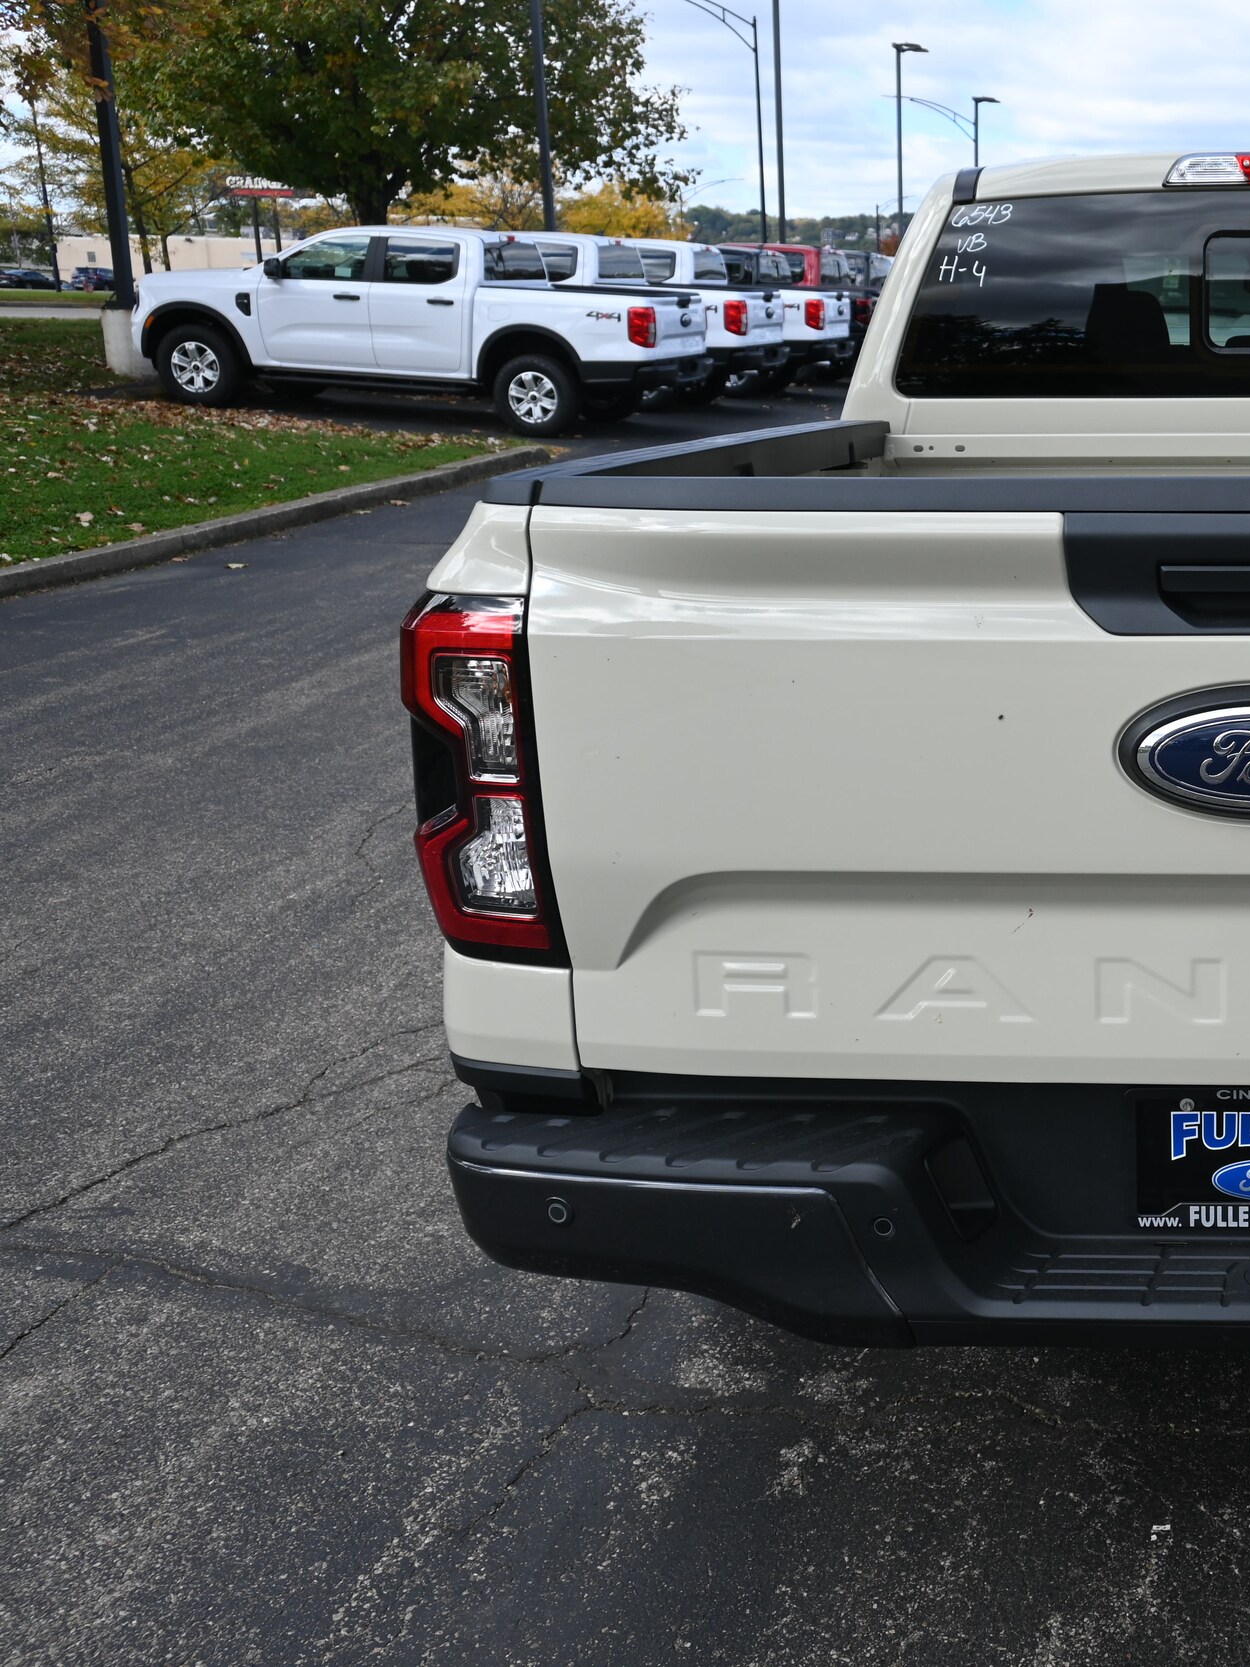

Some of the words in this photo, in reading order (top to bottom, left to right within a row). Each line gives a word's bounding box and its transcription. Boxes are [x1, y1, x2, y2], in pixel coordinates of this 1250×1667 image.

[225, 175, 294, 190] GRAING
[951, 203, 1013, 228] 6543
[1137, 1216, 1182, 1228] www.
